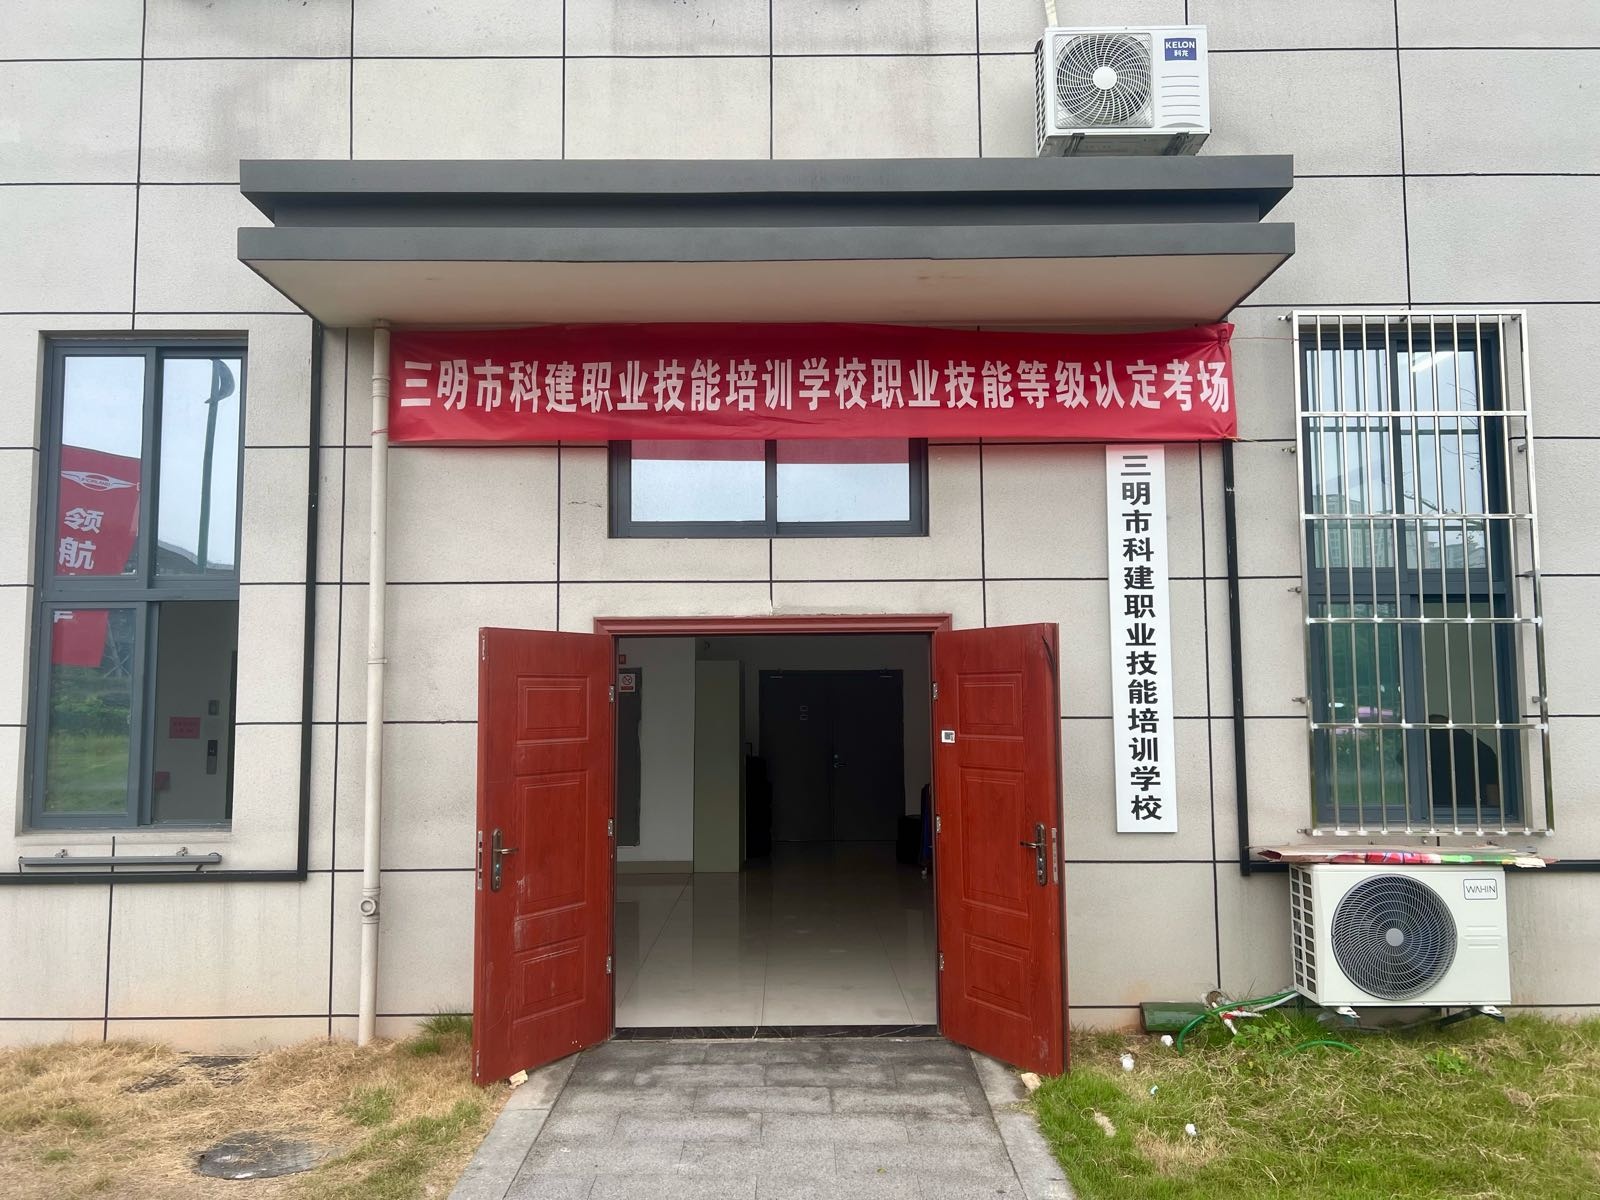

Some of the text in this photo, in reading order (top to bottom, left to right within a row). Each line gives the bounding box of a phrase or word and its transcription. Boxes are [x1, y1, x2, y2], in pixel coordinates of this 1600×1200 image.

[1165, 41, 1196, 49] KELON
[400, 356, 1229, 414] 三明市科建职业技能培训学校职业技能等级认定考场
[1120, 455, 1163, 821] 三明市科建职业技能培训学校
[1465, 885, 1496, 893] WAHIN
